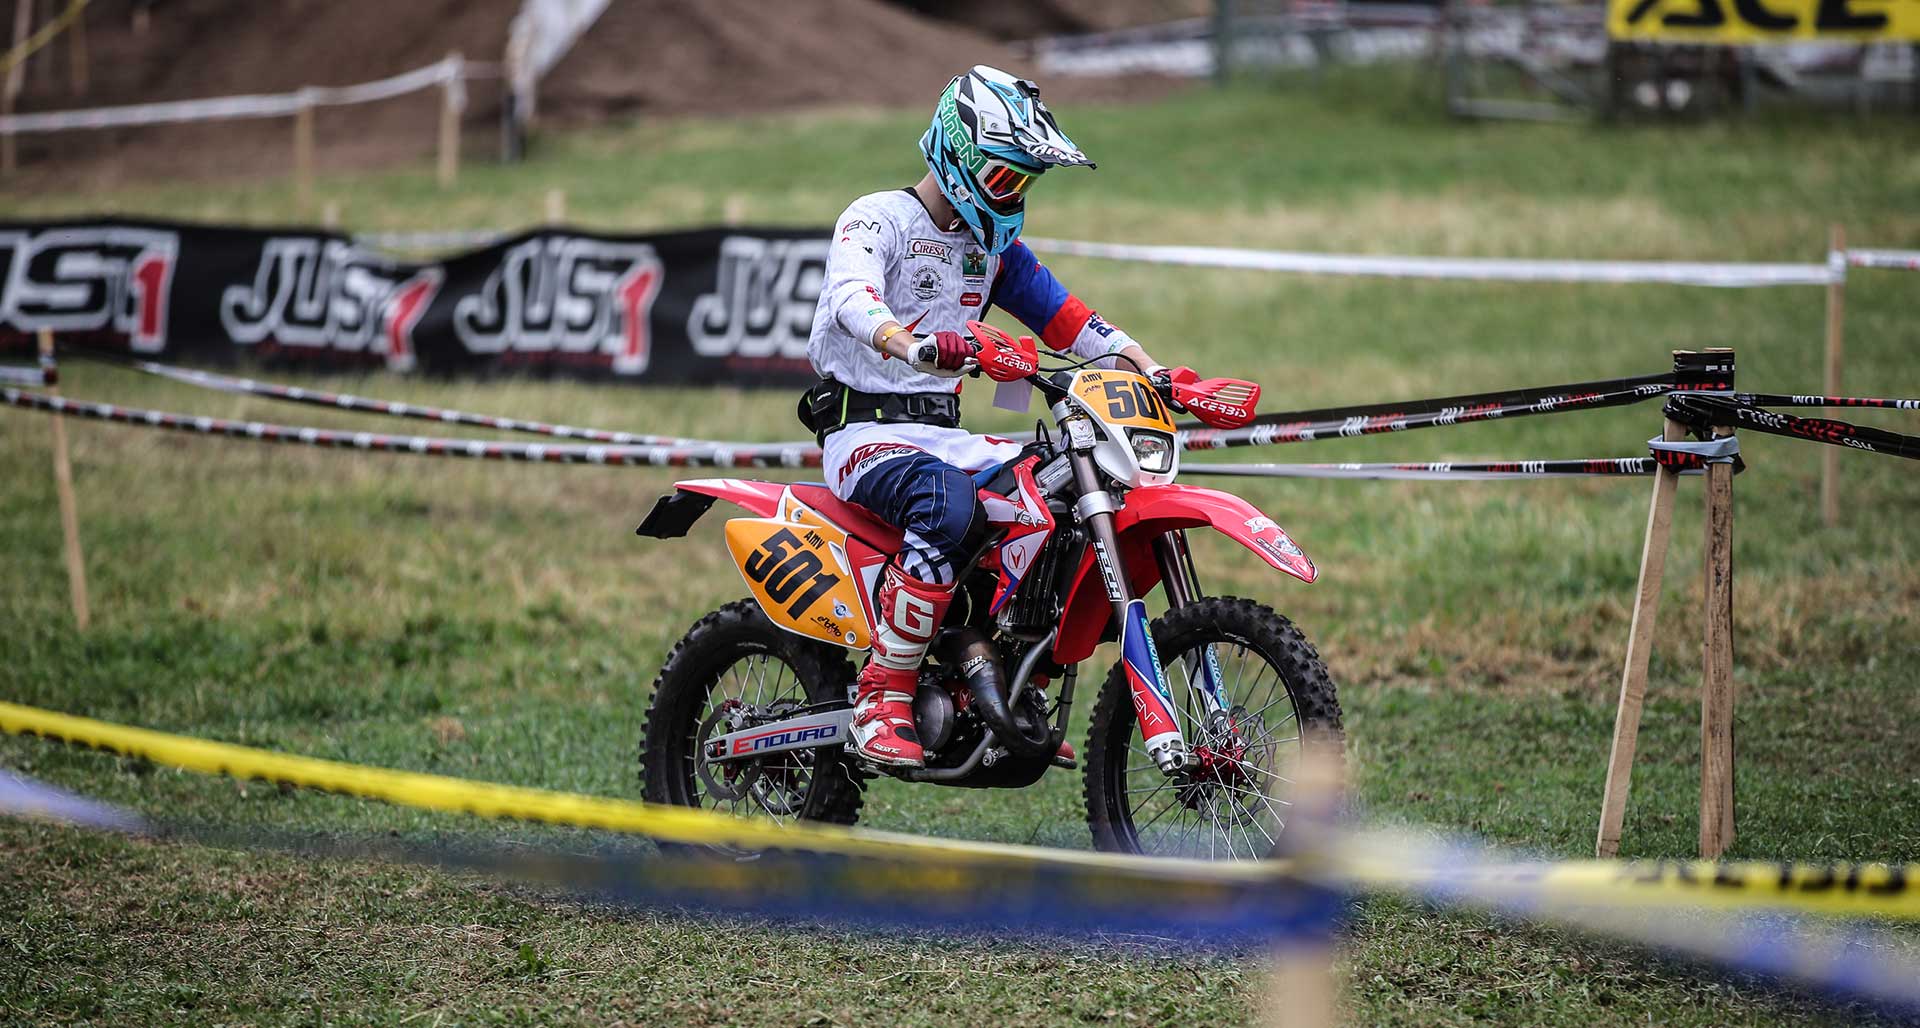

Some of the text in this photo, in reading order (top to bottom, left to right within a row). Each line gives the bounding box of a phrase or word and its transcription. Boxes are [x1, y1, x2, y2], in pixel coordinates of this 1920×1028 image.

[912, 240, 946, 257] CIRESA
[993, 353, 1033, 373] ACERBIS
[1187, 397, 1248, 418] ACERBIS
[744, 527, 841, 621] 501
